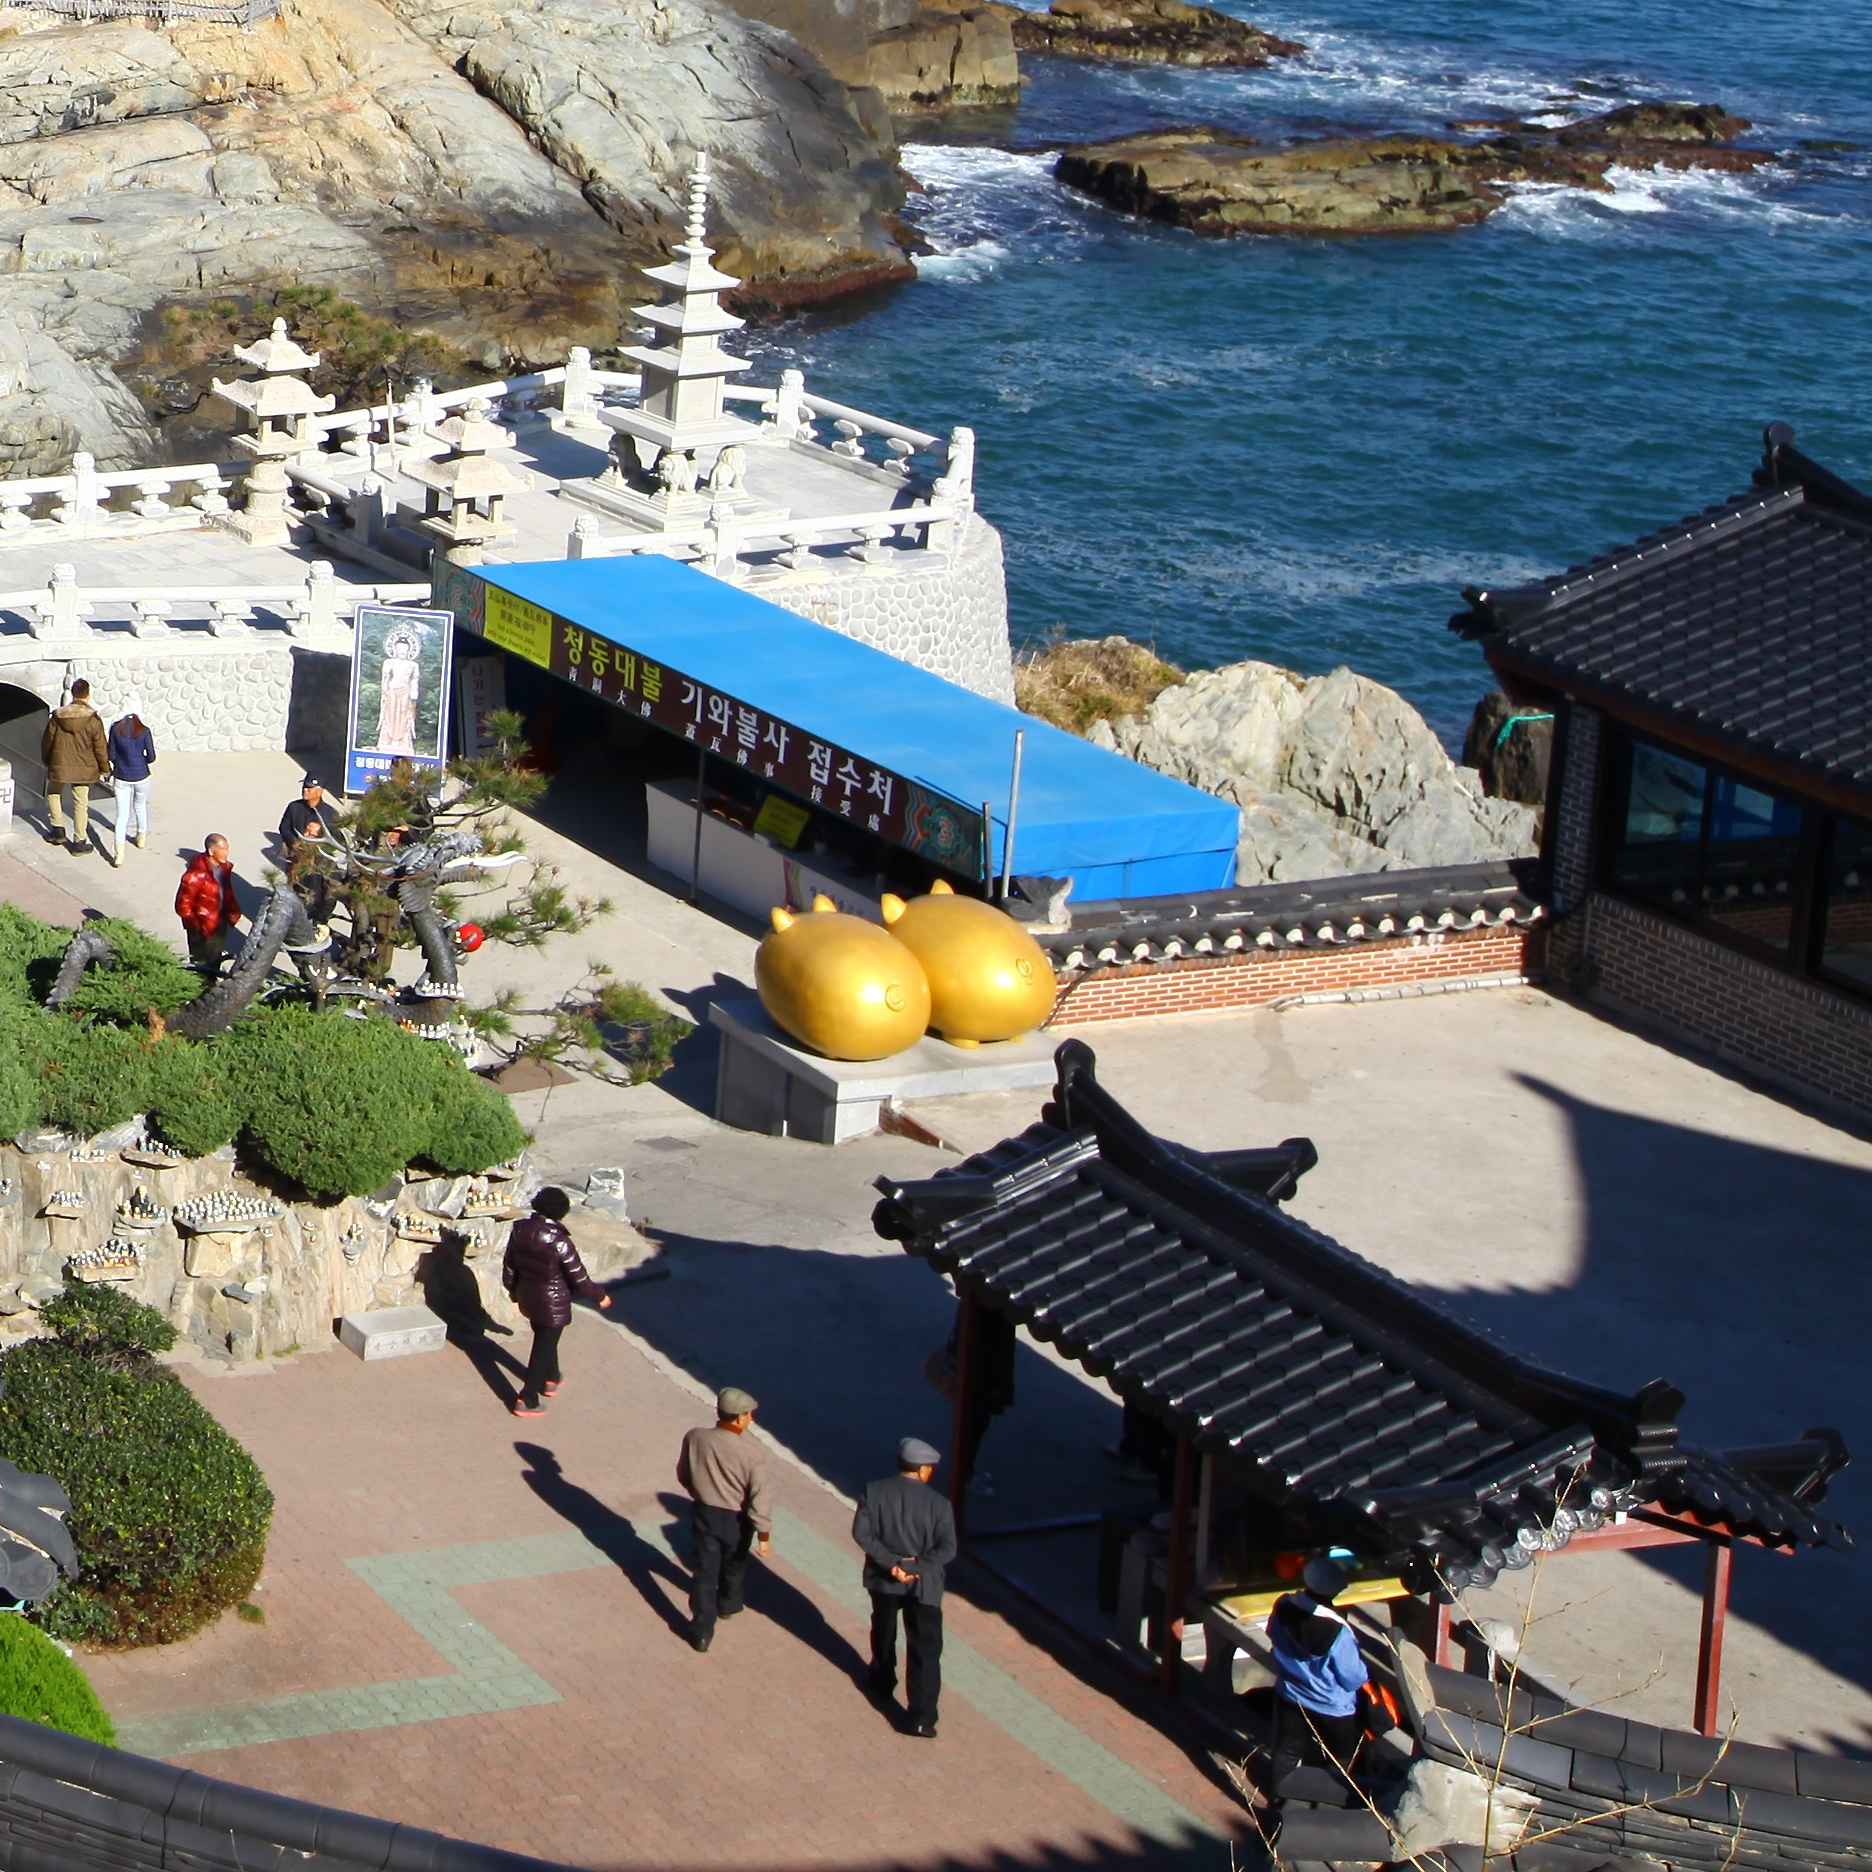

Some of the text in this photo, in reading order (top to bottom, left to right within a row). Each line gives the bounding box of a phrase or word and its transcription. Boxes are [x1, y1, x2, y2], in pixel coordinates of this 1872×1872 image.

[563, 625, 663, 703] 청동대불
[680, 680, 790, 764] 기와불사
[807, 740, 894, 816] 접수처
